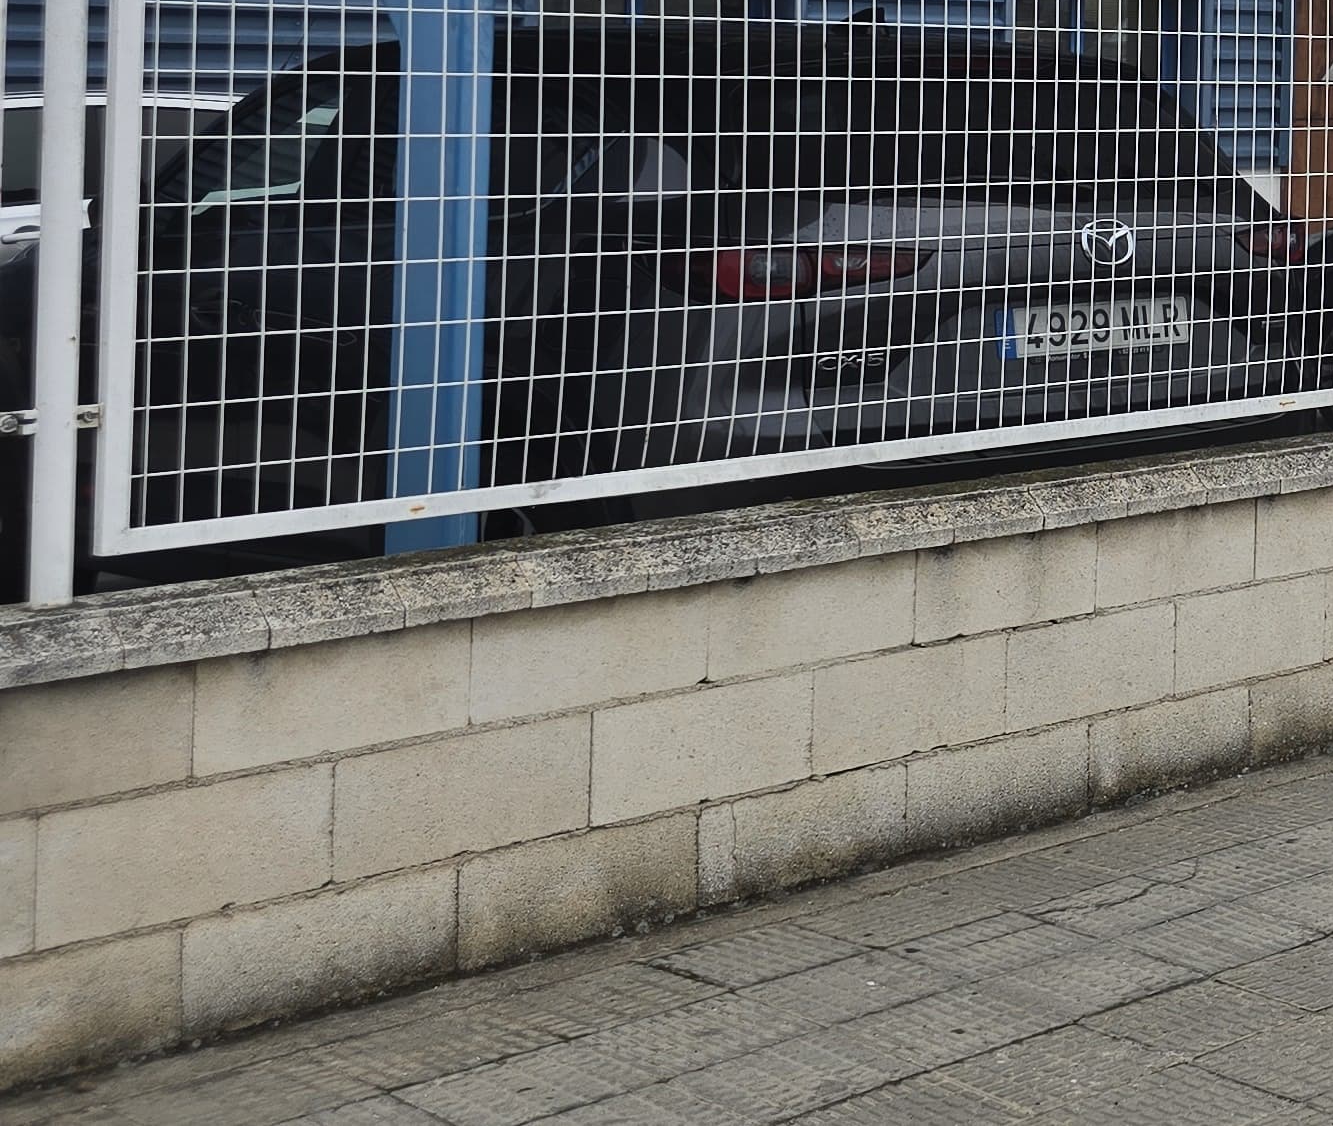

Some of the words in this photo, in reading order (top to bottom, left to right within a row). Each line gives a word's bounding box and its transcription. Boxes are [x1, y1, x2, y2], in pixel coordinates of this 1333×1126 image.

[1027, 309, 1110, 348] 4929
[1121, 304, 1181, 341] MLR
[818, 353, 884, 370] CX-5
